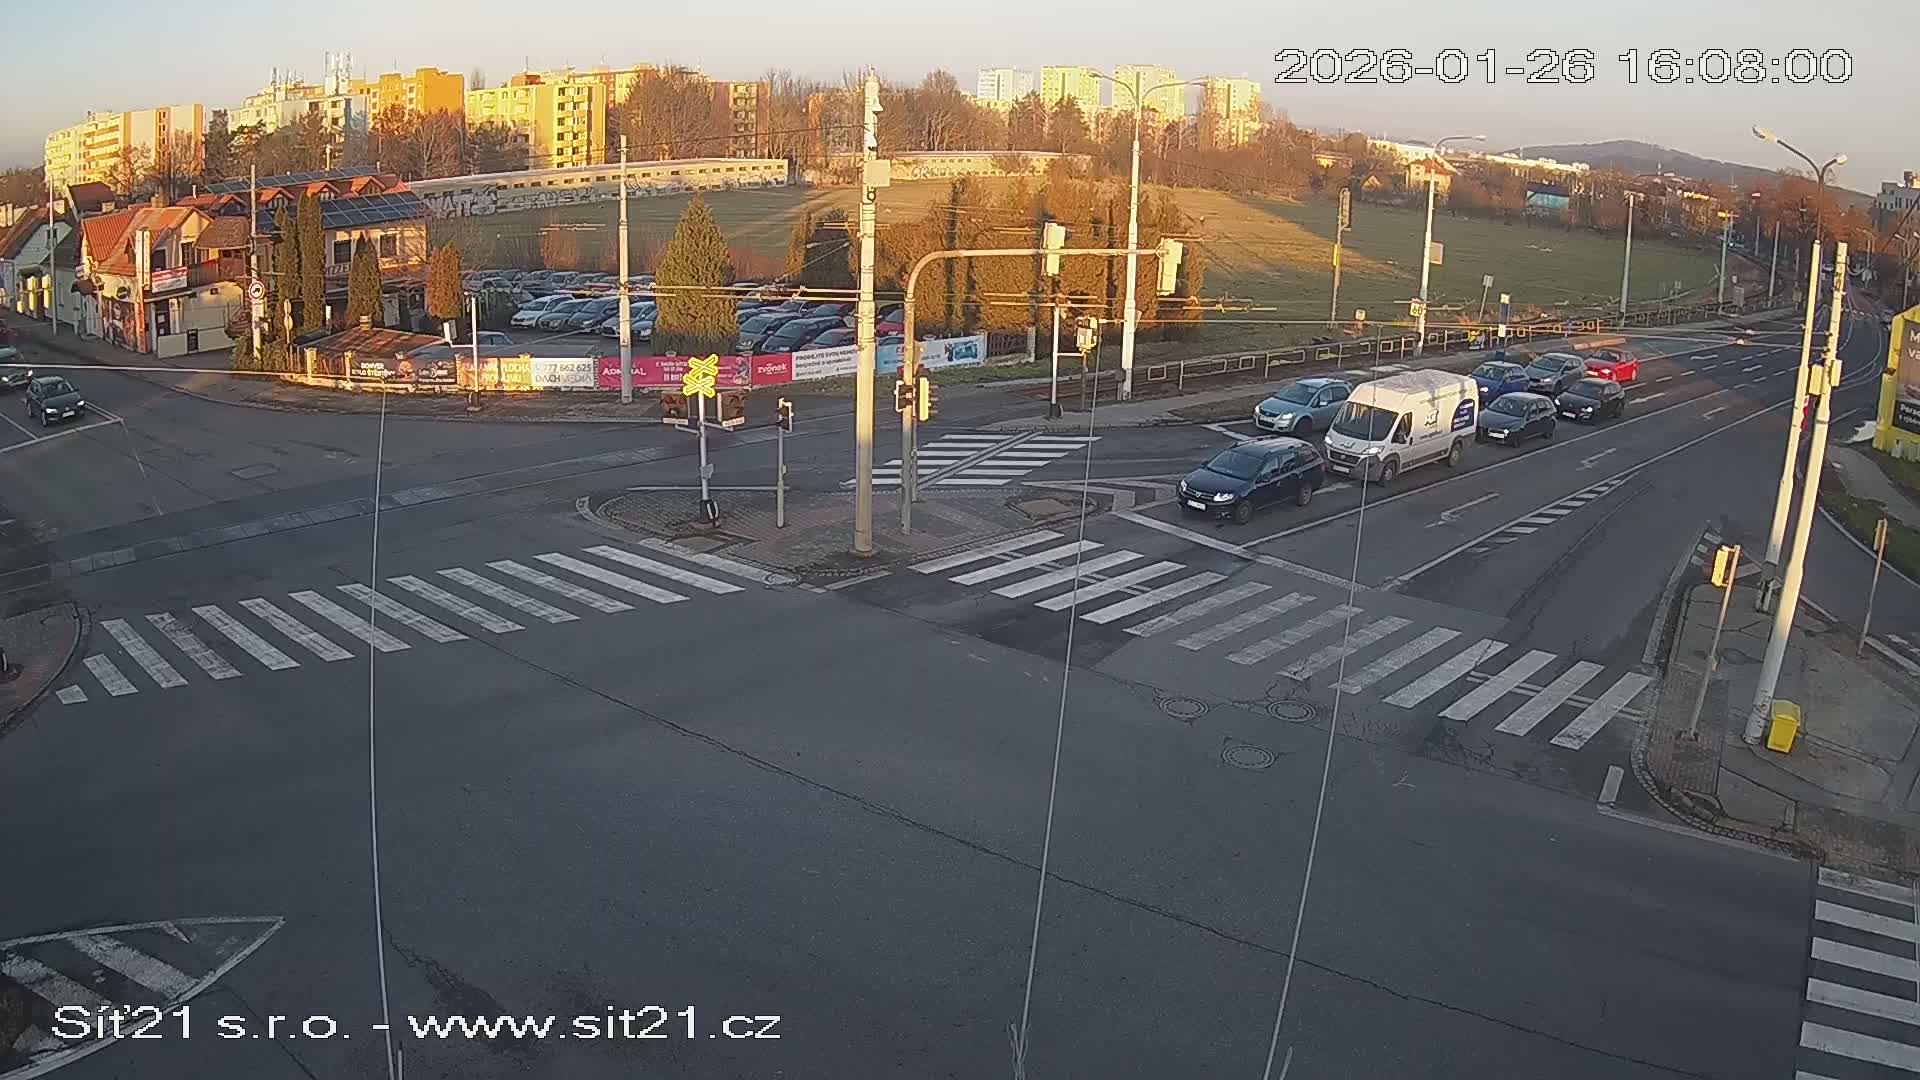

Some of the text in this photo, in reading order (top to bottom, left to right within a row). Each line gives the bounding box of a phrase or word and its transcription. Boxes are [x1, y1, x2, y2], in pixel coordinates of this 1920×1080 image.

[1412, 305, 1423, 315] 60
[543, 364, 592, 373] 777 862 625
[535, 374, 561, 383] DACH
